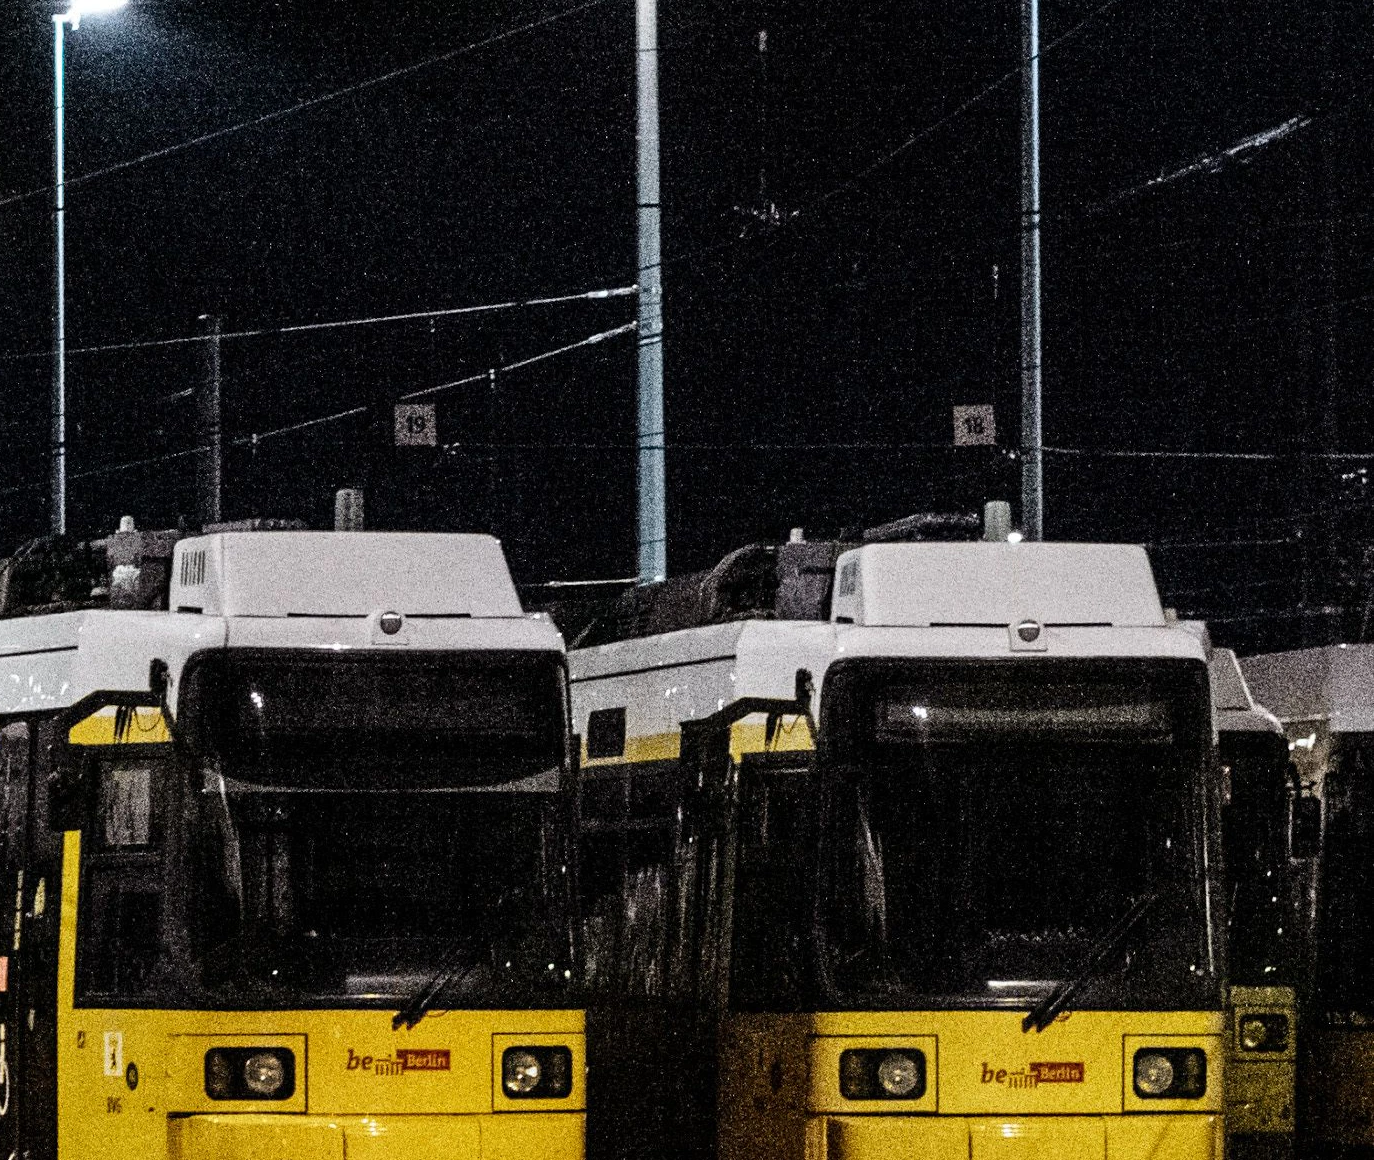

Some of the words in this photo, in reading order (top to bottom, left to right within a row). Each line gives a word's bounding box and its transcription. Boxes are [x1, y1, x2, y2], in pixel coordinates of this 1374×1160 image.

[405, 415, 426, 434] 19
[964, 416, 984, 434] 18
[346, 1048, 373, 1071] be
[406, 1052, 447, 1068] Berlin
[980, 1062, 1007, 1084] be
[1039, 1065, 1081, 1081] Berlin
